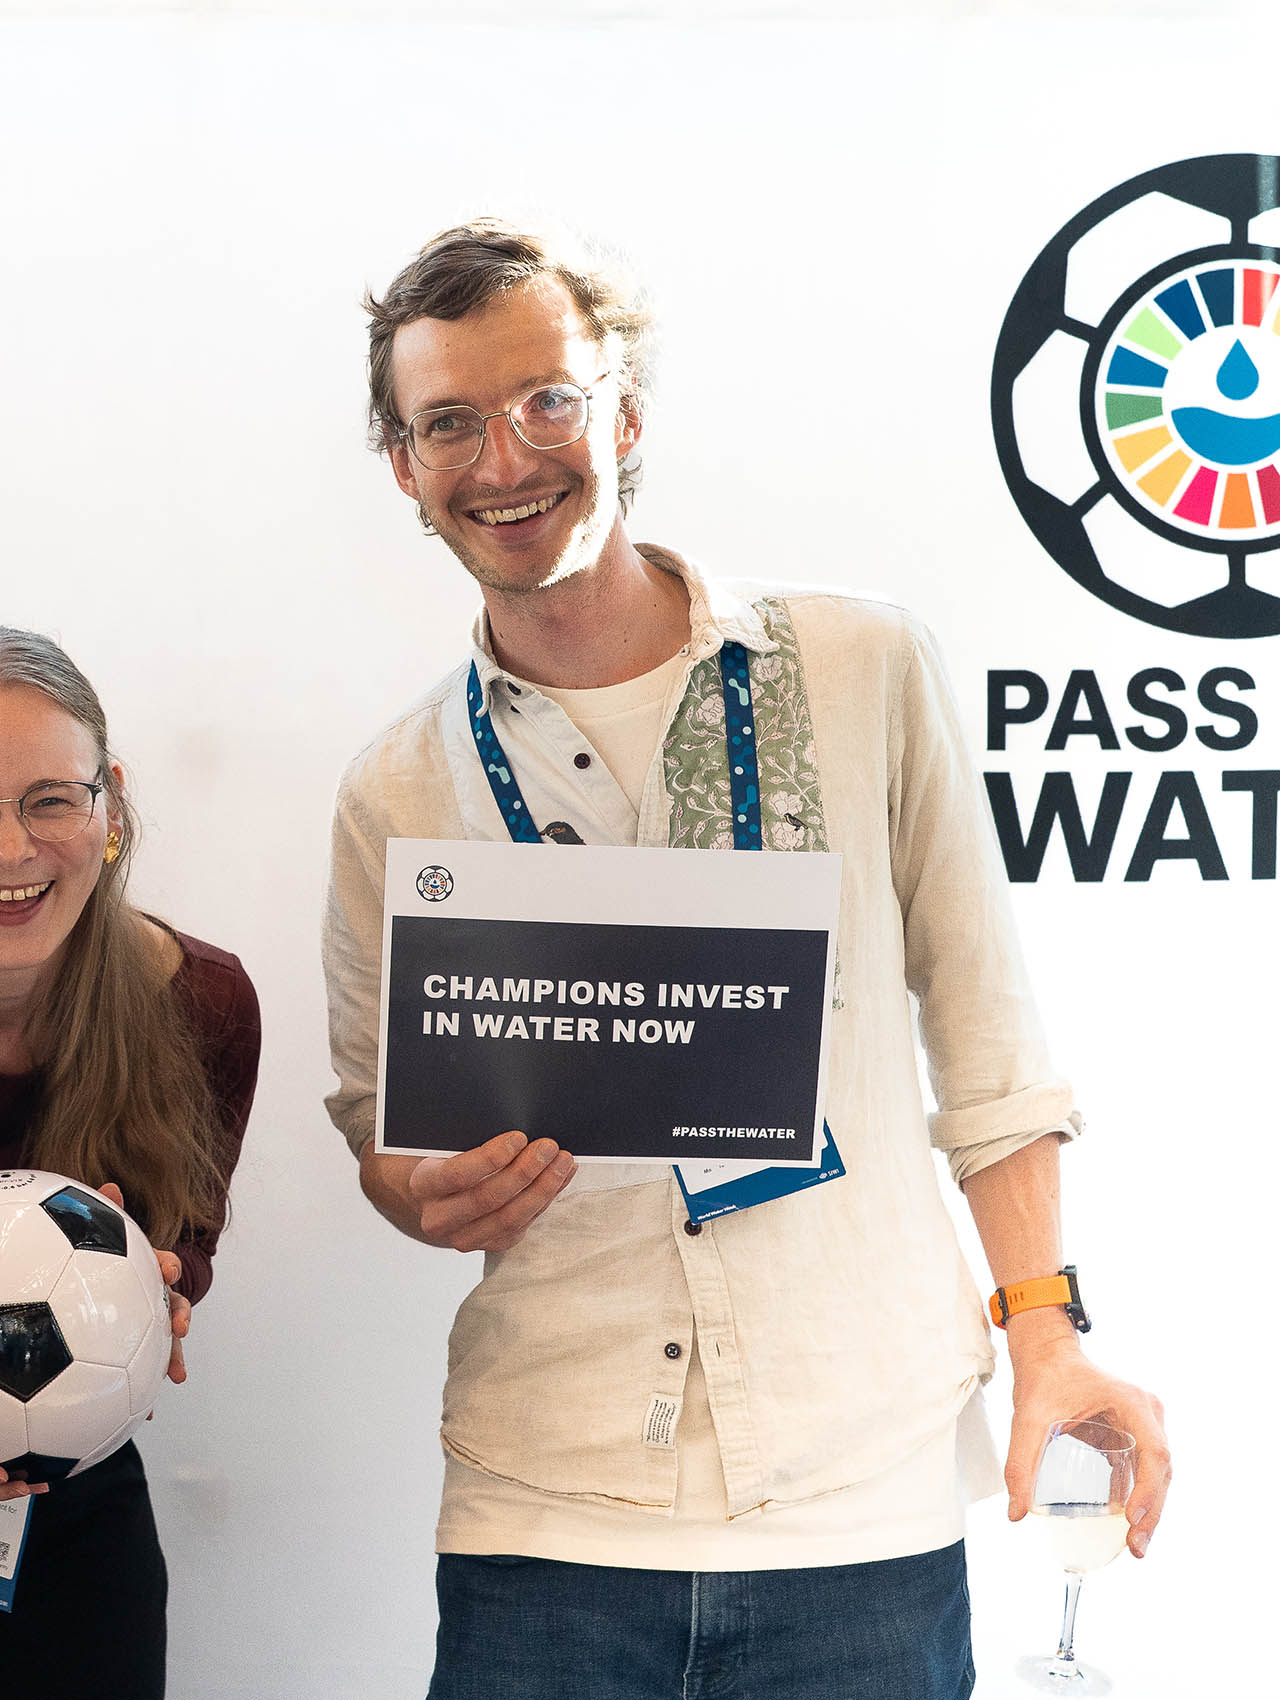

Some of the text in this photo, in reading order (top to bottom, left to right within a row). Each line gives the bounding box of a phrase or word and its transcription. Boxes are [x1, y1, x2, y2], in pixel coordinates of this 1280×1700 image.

[986, 667, 1259, 752] PASS
[423, 974, 790, 1010] CHAMPIONS INVEST
[422, 1011, 696, 1044] IN WATER NOW
[672, 1126, 796, 1139] #PASSTHEWATER
